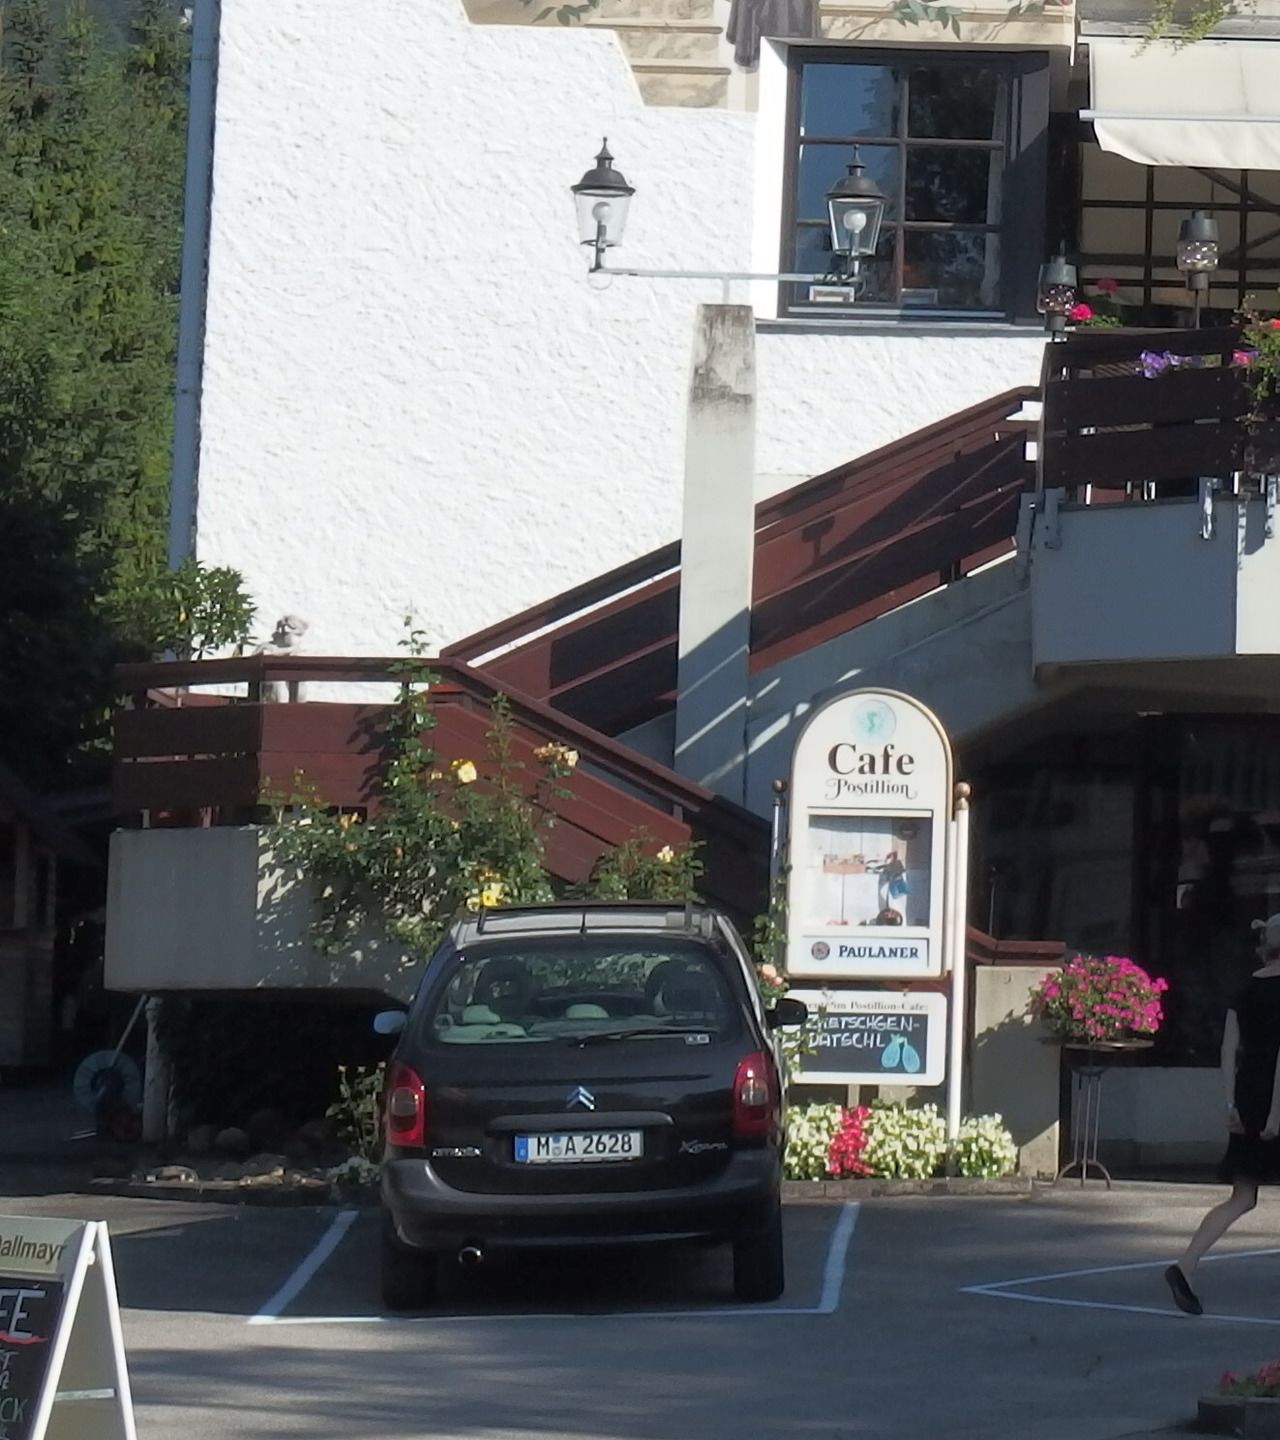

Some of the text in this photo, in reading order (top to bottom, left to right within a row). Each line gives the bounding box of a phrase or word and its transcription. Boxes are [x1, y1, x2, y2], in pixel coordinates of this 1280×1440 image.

[827, 742, 915, 775] Cafe
[824, 778, 919, 800] Postillion
[838, 945, 920, 959] PAULANER
[536, 1133, 634, 1157] M A 2628
